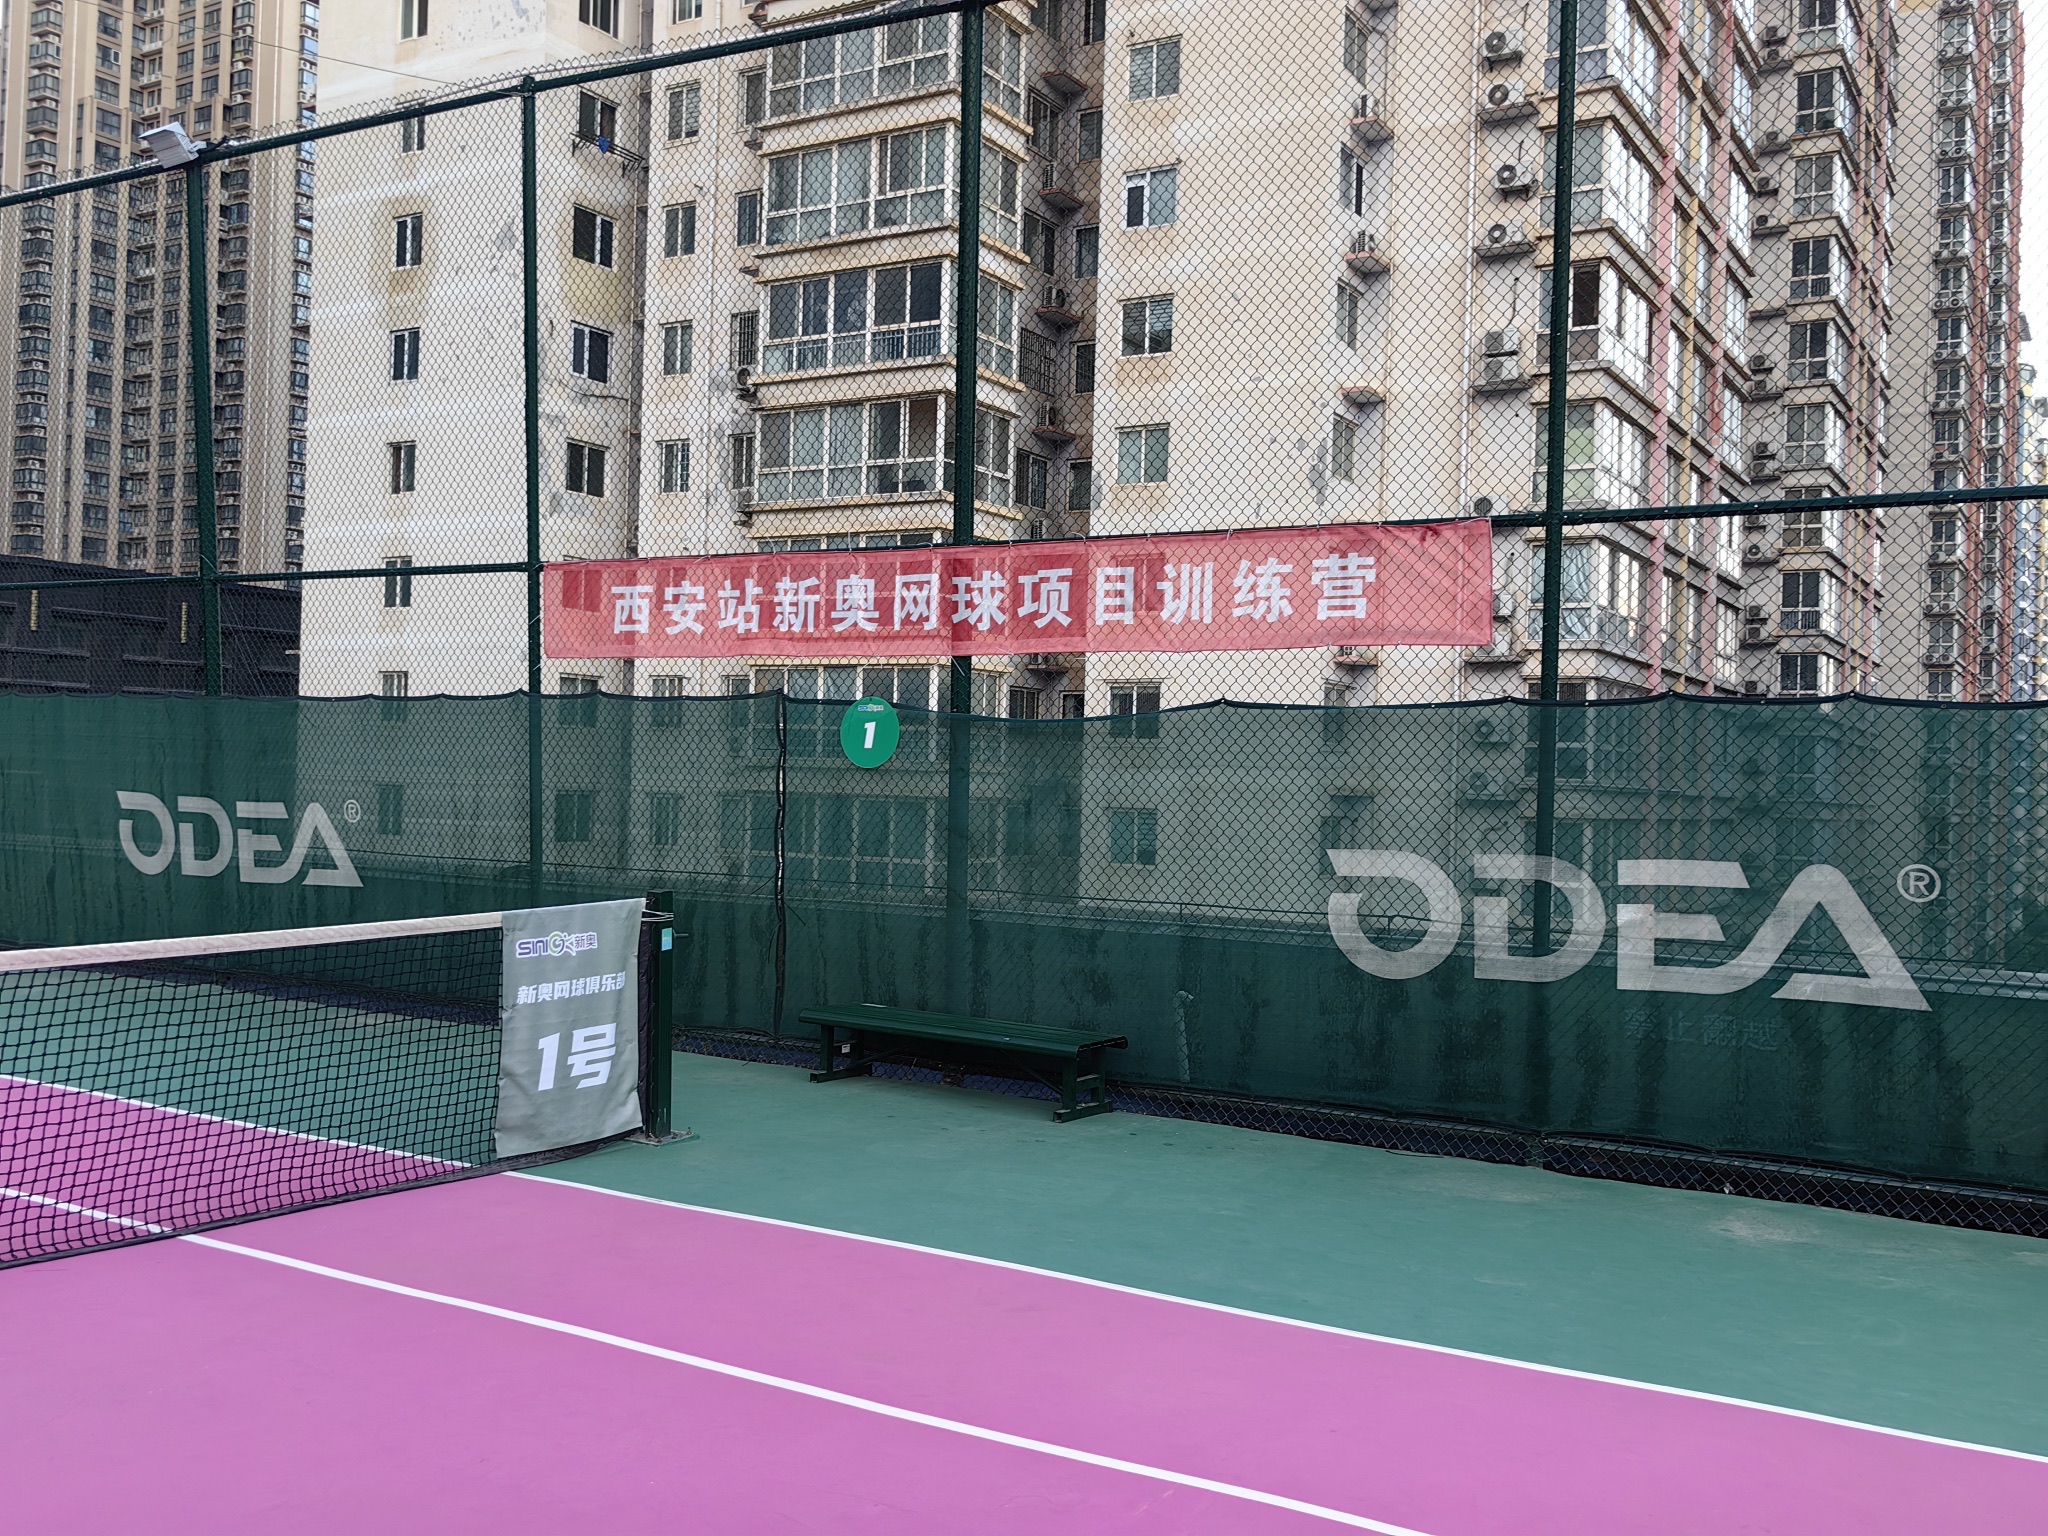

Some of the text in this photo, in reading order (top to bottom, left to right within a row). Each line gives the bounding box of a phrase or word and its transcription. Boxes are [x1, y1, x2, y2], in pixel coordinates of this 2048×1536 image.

[610, 551, 1377, 635] 西安站新奥网球项目训练营
[863, 721, 877, 749] 1
[116, 790, 364, 888] ODEA
[574, 933, 597, 950] 新奥
[1327, 848, 1933, 1012] ODEA
[537, 1022, 617, 1092] 1号
